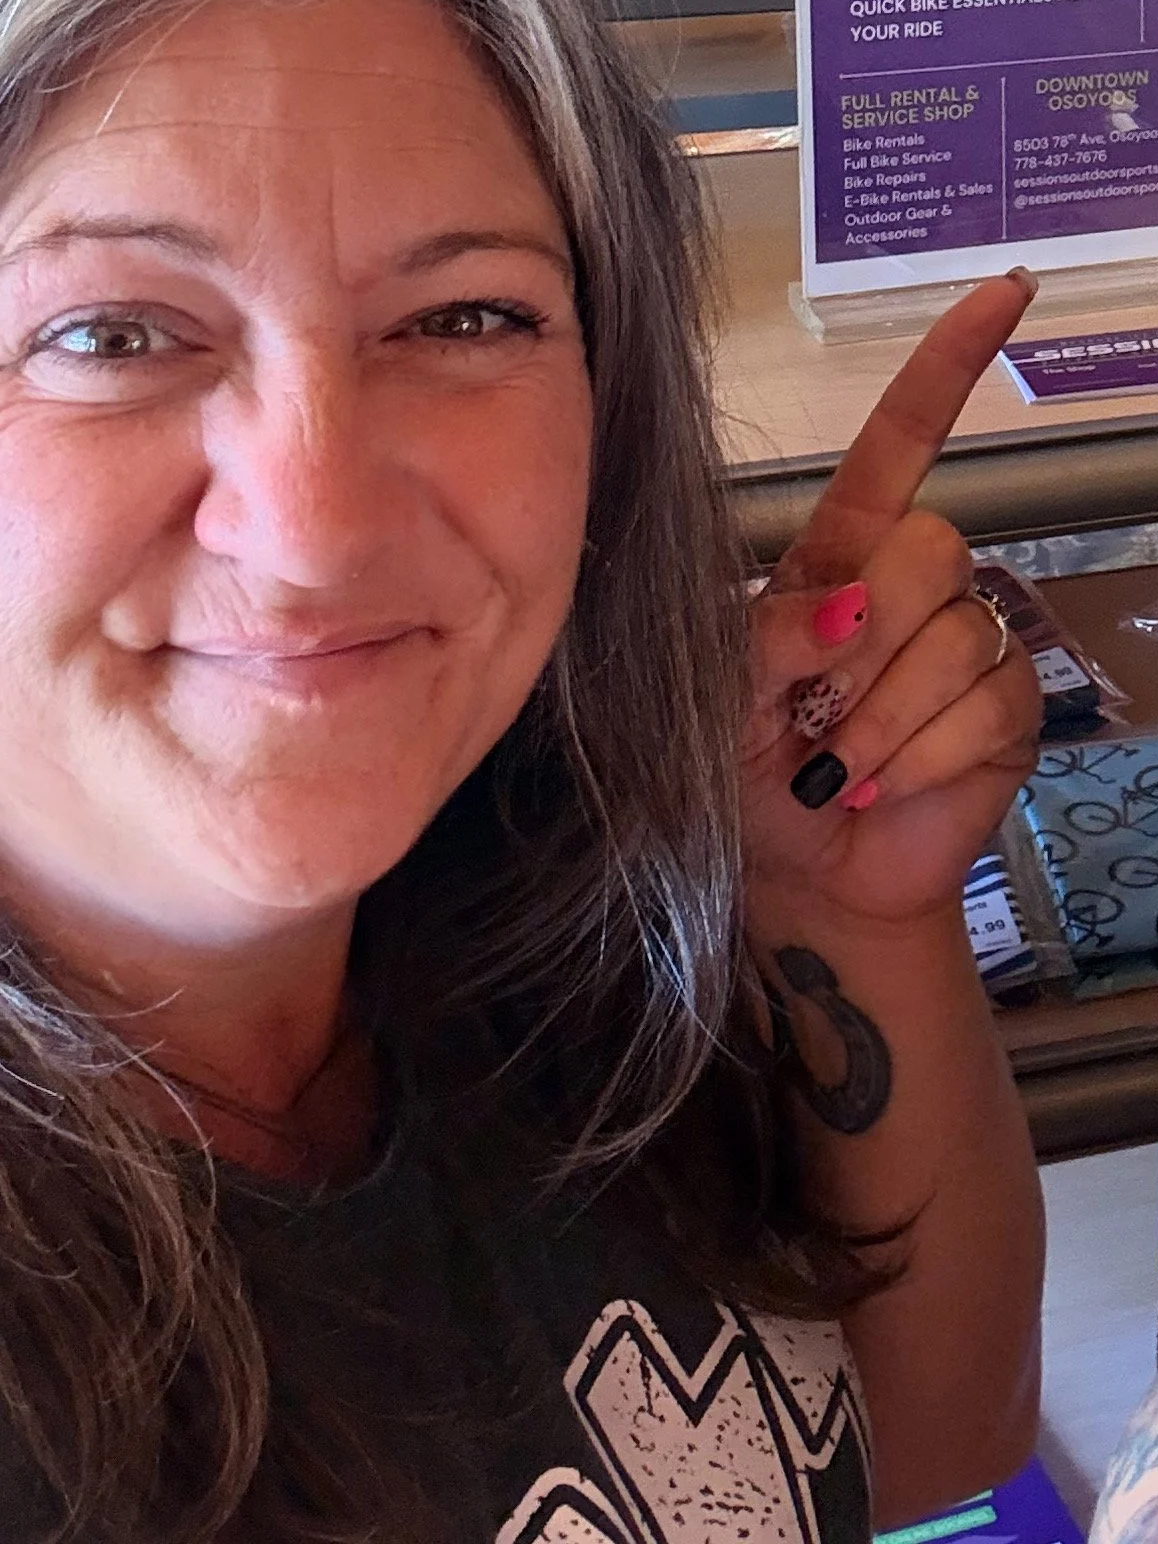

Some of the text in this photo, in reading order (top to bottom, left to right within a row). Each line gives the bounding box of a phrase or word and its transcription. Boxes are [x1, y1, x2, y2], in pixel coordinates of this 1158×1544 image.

[850, 20, 944, 42] YOUR RIDE
[1035, 69, 1150, 95] DOWNTOWN
[841, 84, 980, 111] FULL RENTAL &
[1049, 88, 1138, 111] OSOYOOS
[842, 103, 975, 130] SERVICE SHOP
[843, 132, 926, 153] Bike Rentals
[1013, 137, 1049, 152] 8503
[844, 149, 953, 171] Full Bike Service
[1014, 149, 1108, 172] 778-437-7676
[844, 170, 927, 190] Bike Repairs
[844, 181, 994, 208] E-Bike Rentals & Sales
[844, 203, 953, 227] Outdoor Gear &
[845, 225, 929, 246] Accessories
